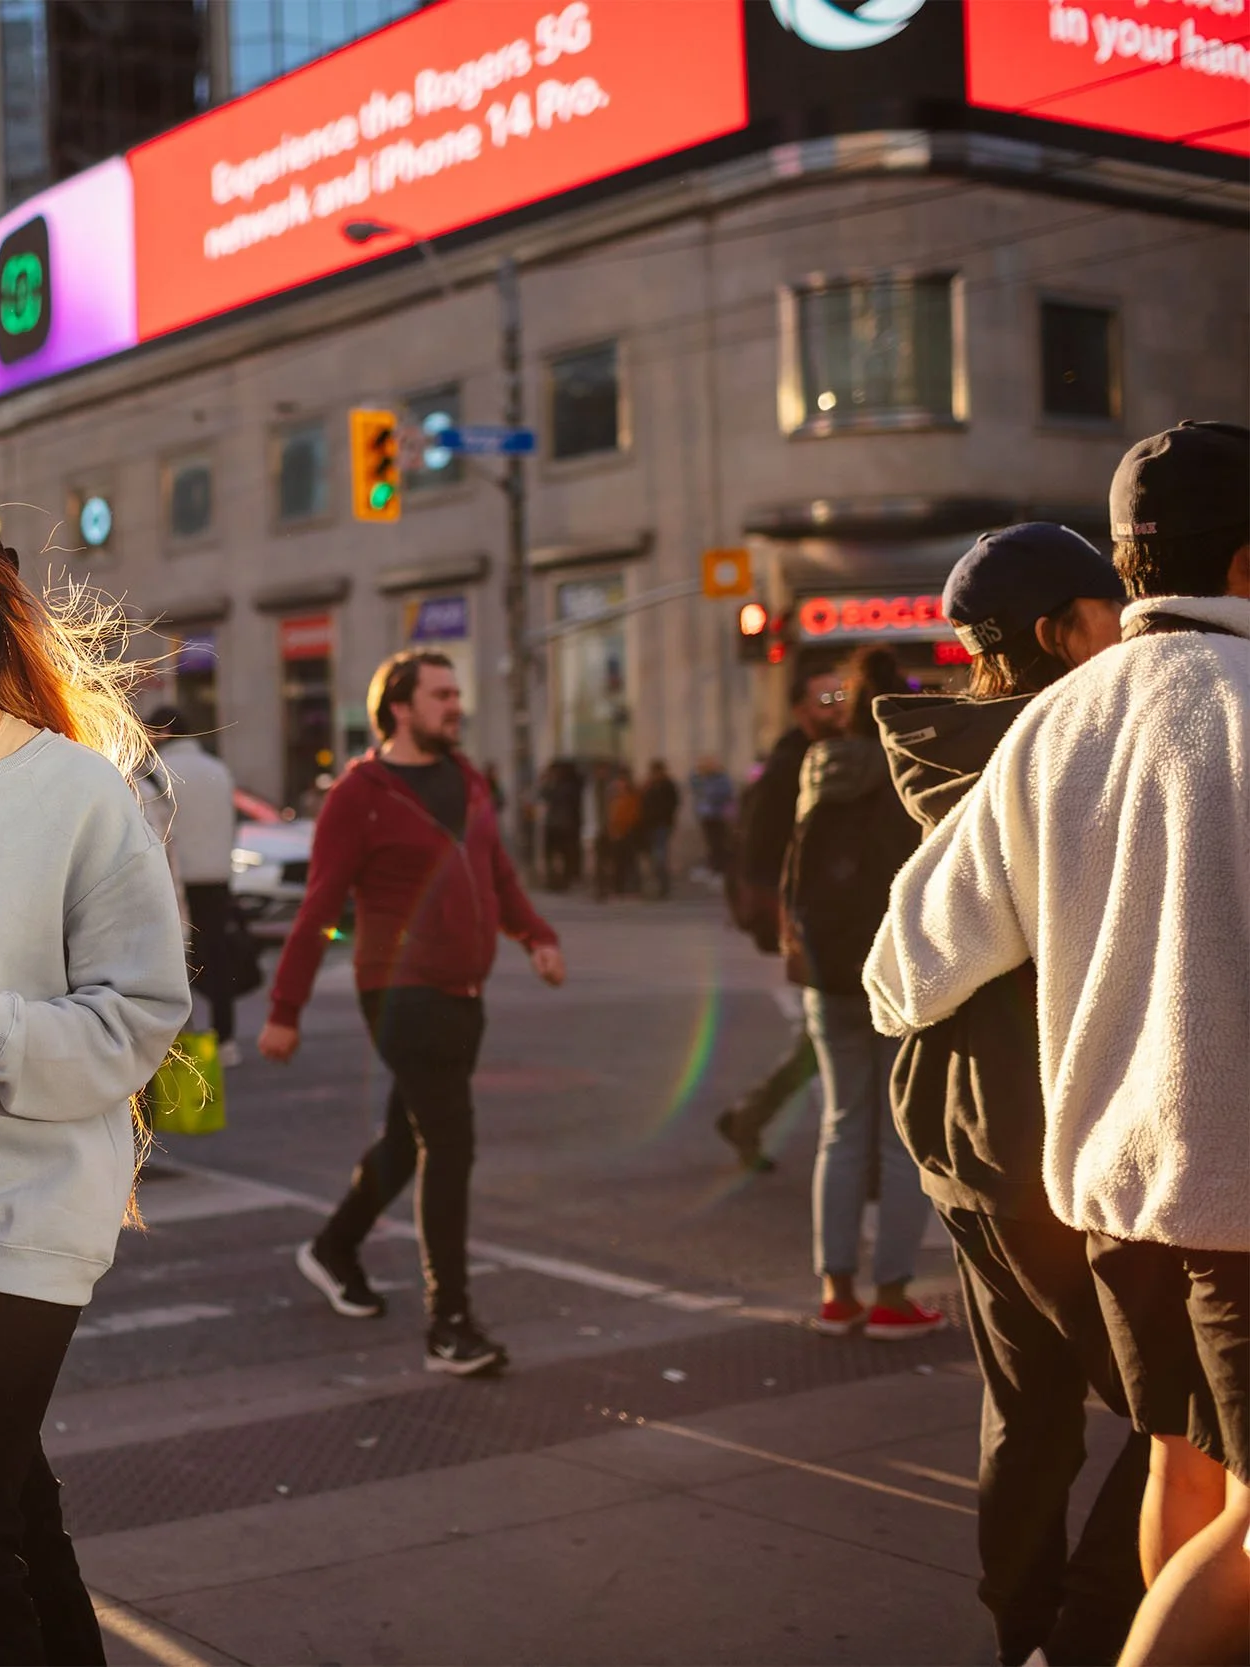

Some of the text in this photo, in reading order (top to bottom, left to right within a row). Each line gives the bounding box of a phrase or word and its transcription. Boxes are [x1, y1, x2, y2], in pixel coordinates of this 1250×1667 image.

[211, 1, 592, 205] Experience the Rogers 5G
[1049, 0, 1250, 84] in your han
[204, 76, 610, 259] network and iPhone 14 Pro.
